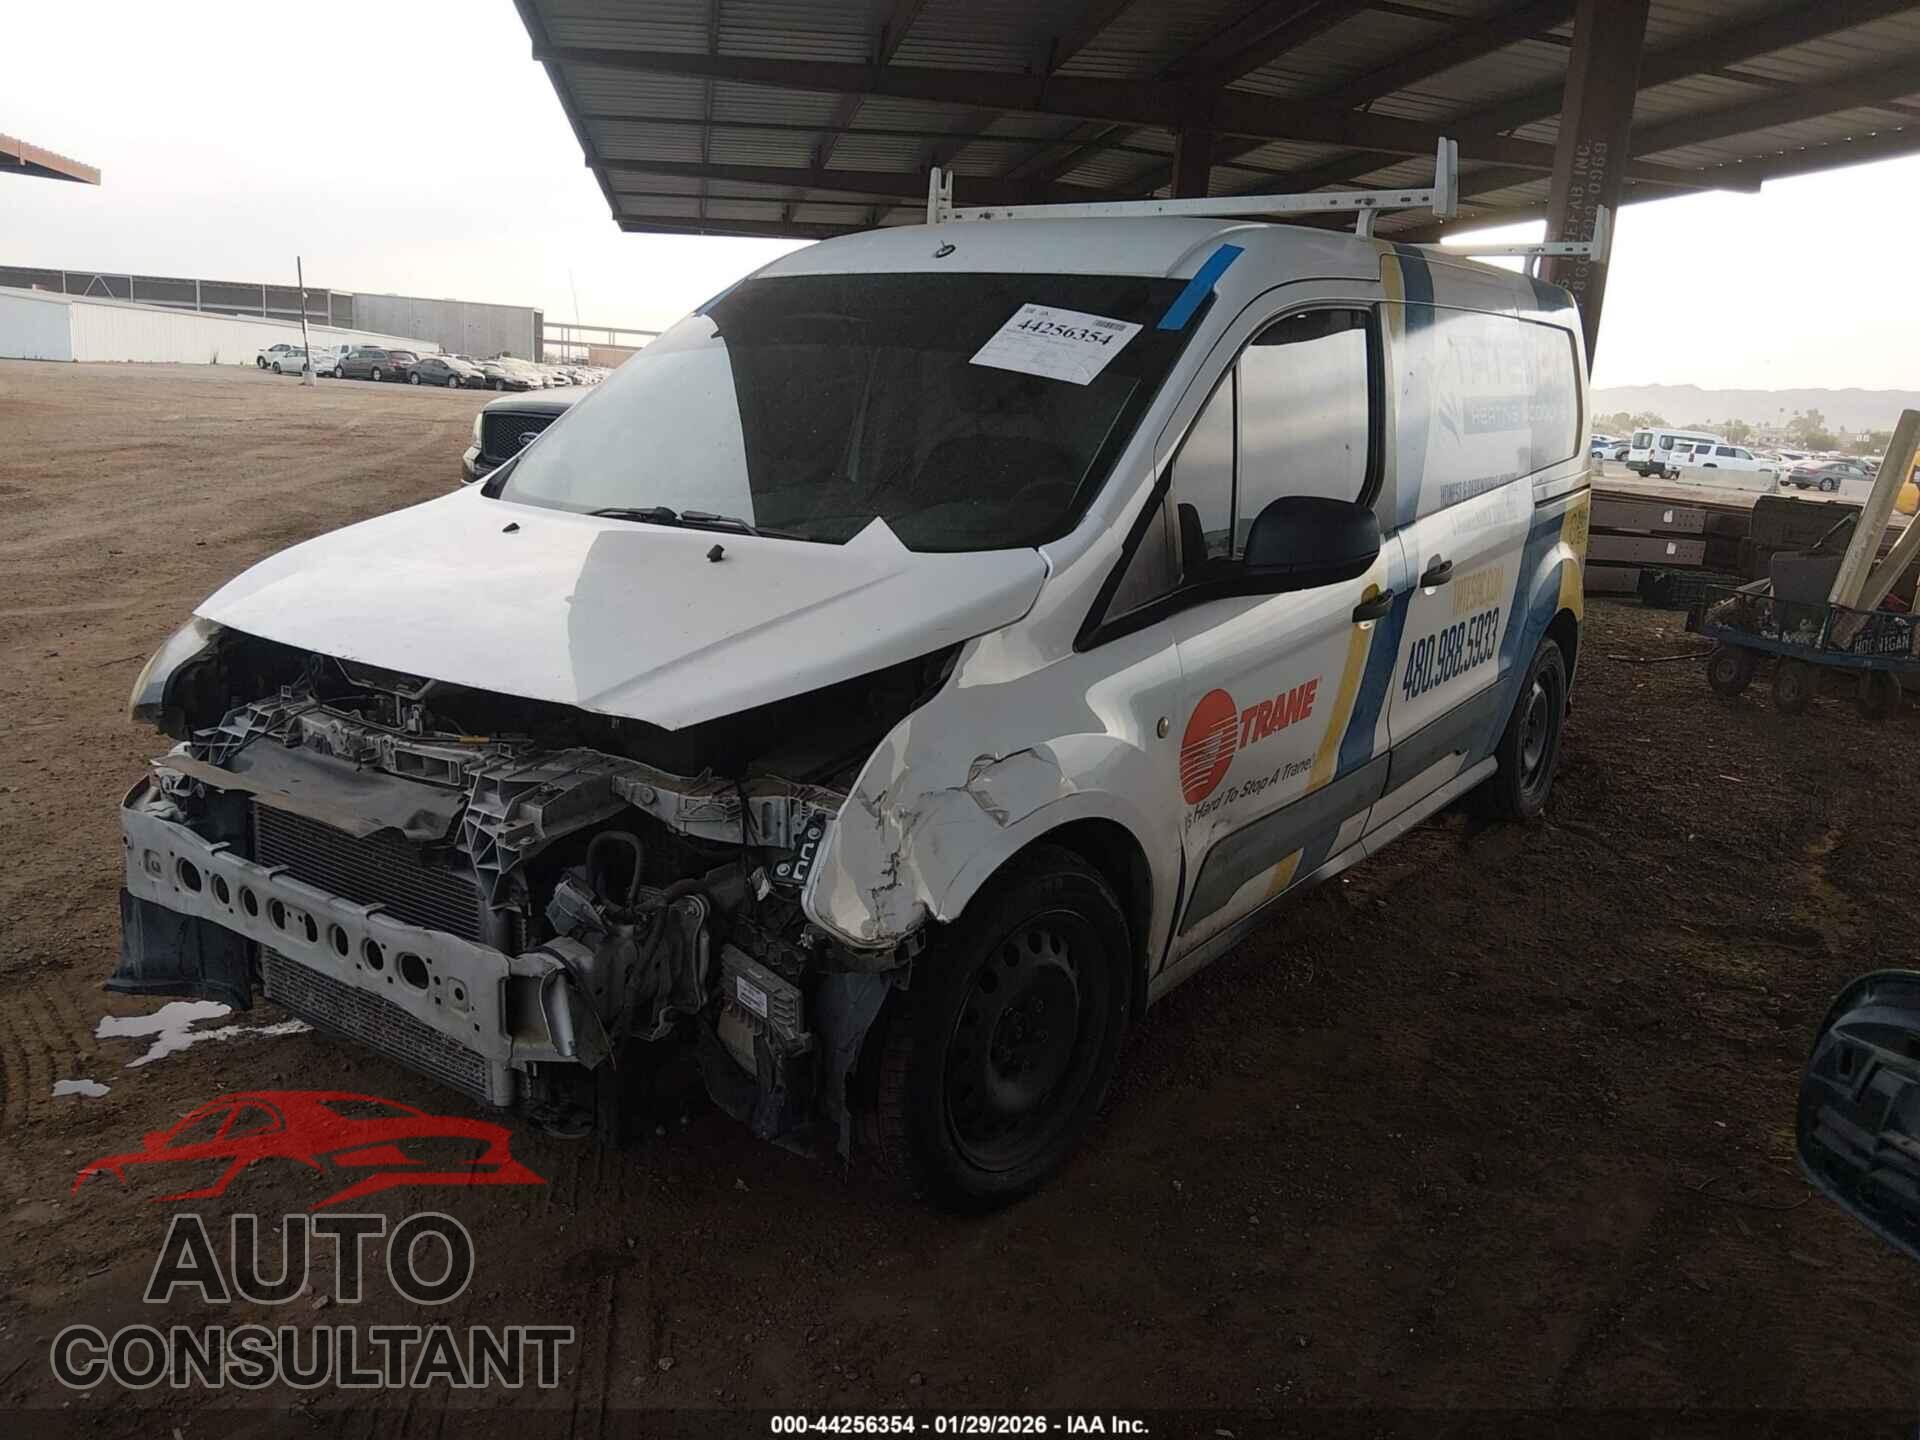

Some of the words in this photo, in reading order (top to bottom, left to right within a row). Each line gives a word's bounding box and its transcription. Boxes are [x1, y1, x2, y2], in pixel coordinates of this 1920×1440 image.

[1016, 318, 1116, 347] 44256354
[1402, 607, 1500, 702] 480.988.5933
[1238, 679, 1319, 751] TRANE
[1193, 791, 1224, 823] Hard
[1224, 786, 1240, 806] To
[1239, 776, 1270, 798] Stop
[1268, 767, 1282, 787] A
